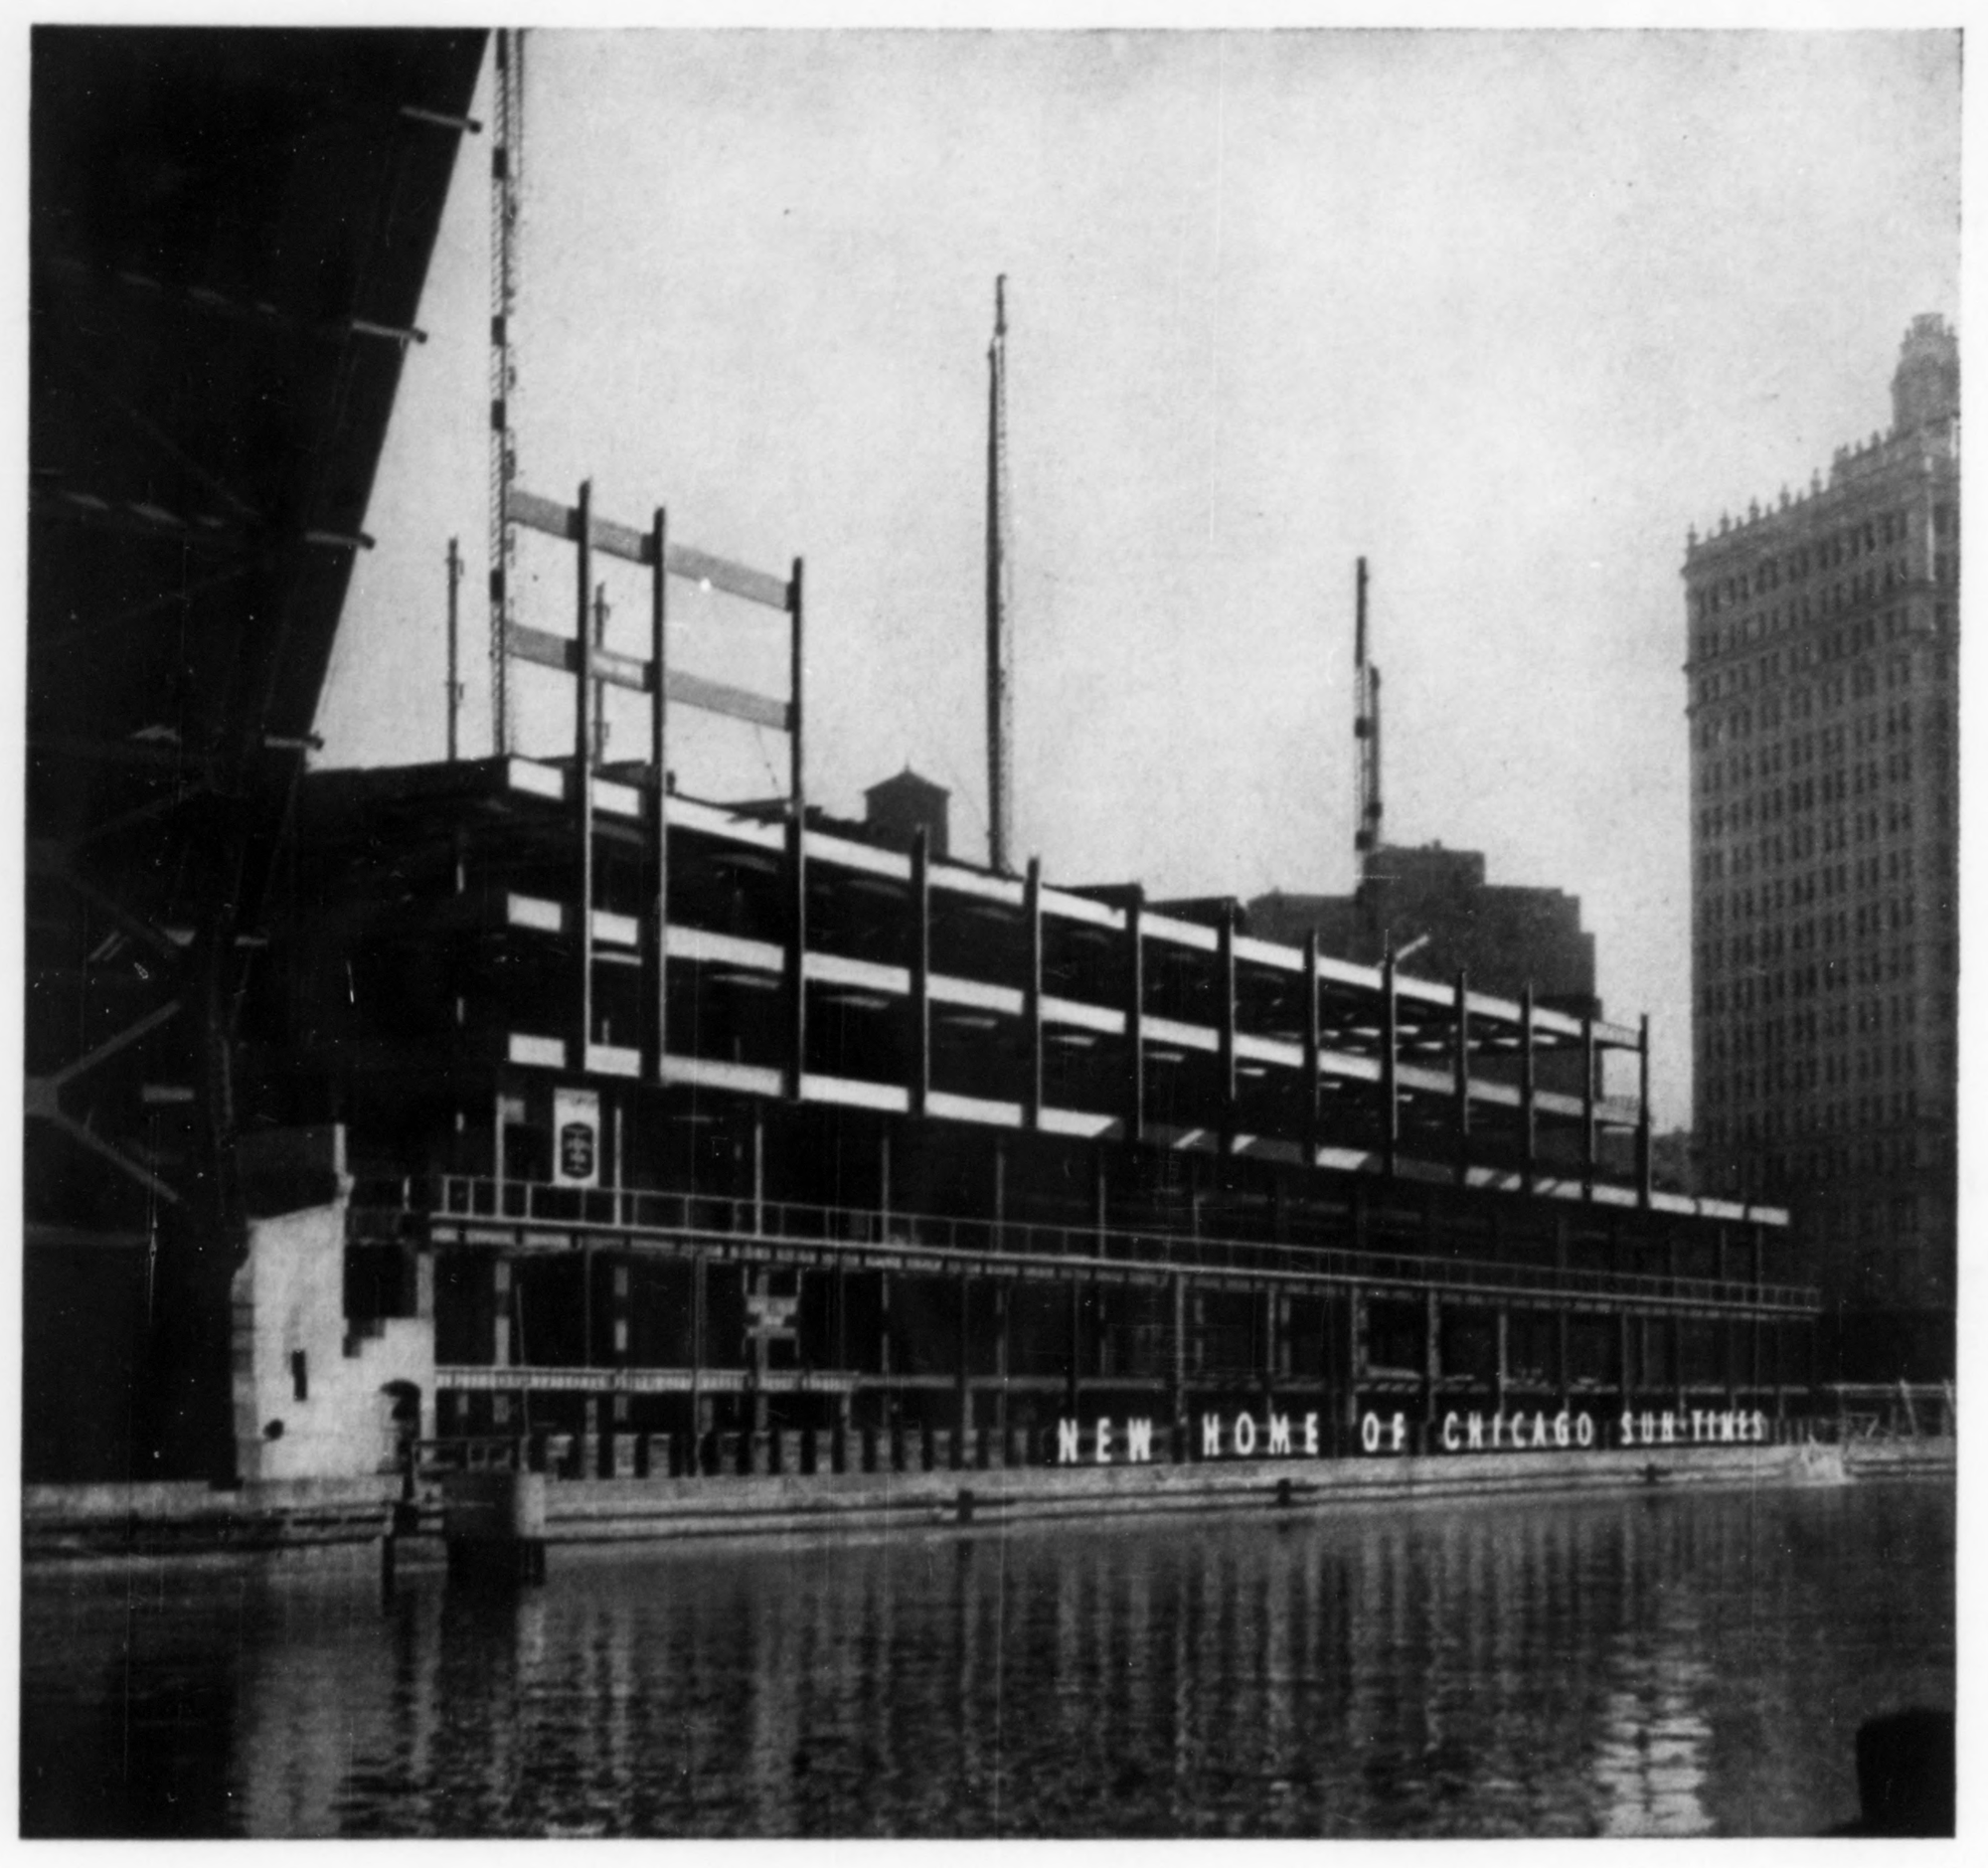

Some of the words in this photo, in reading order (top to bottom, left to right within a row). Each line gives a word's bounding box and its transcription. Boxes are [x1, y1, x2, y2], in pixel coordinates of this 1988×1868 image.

[1058, 1418, 1152, 1462] NEW
[1202, 1412, 1318, 1456] HOME
[1362, 1412, 1406, 1452] OF
[1442, 1411, 1592, 1449] CHICAGO
